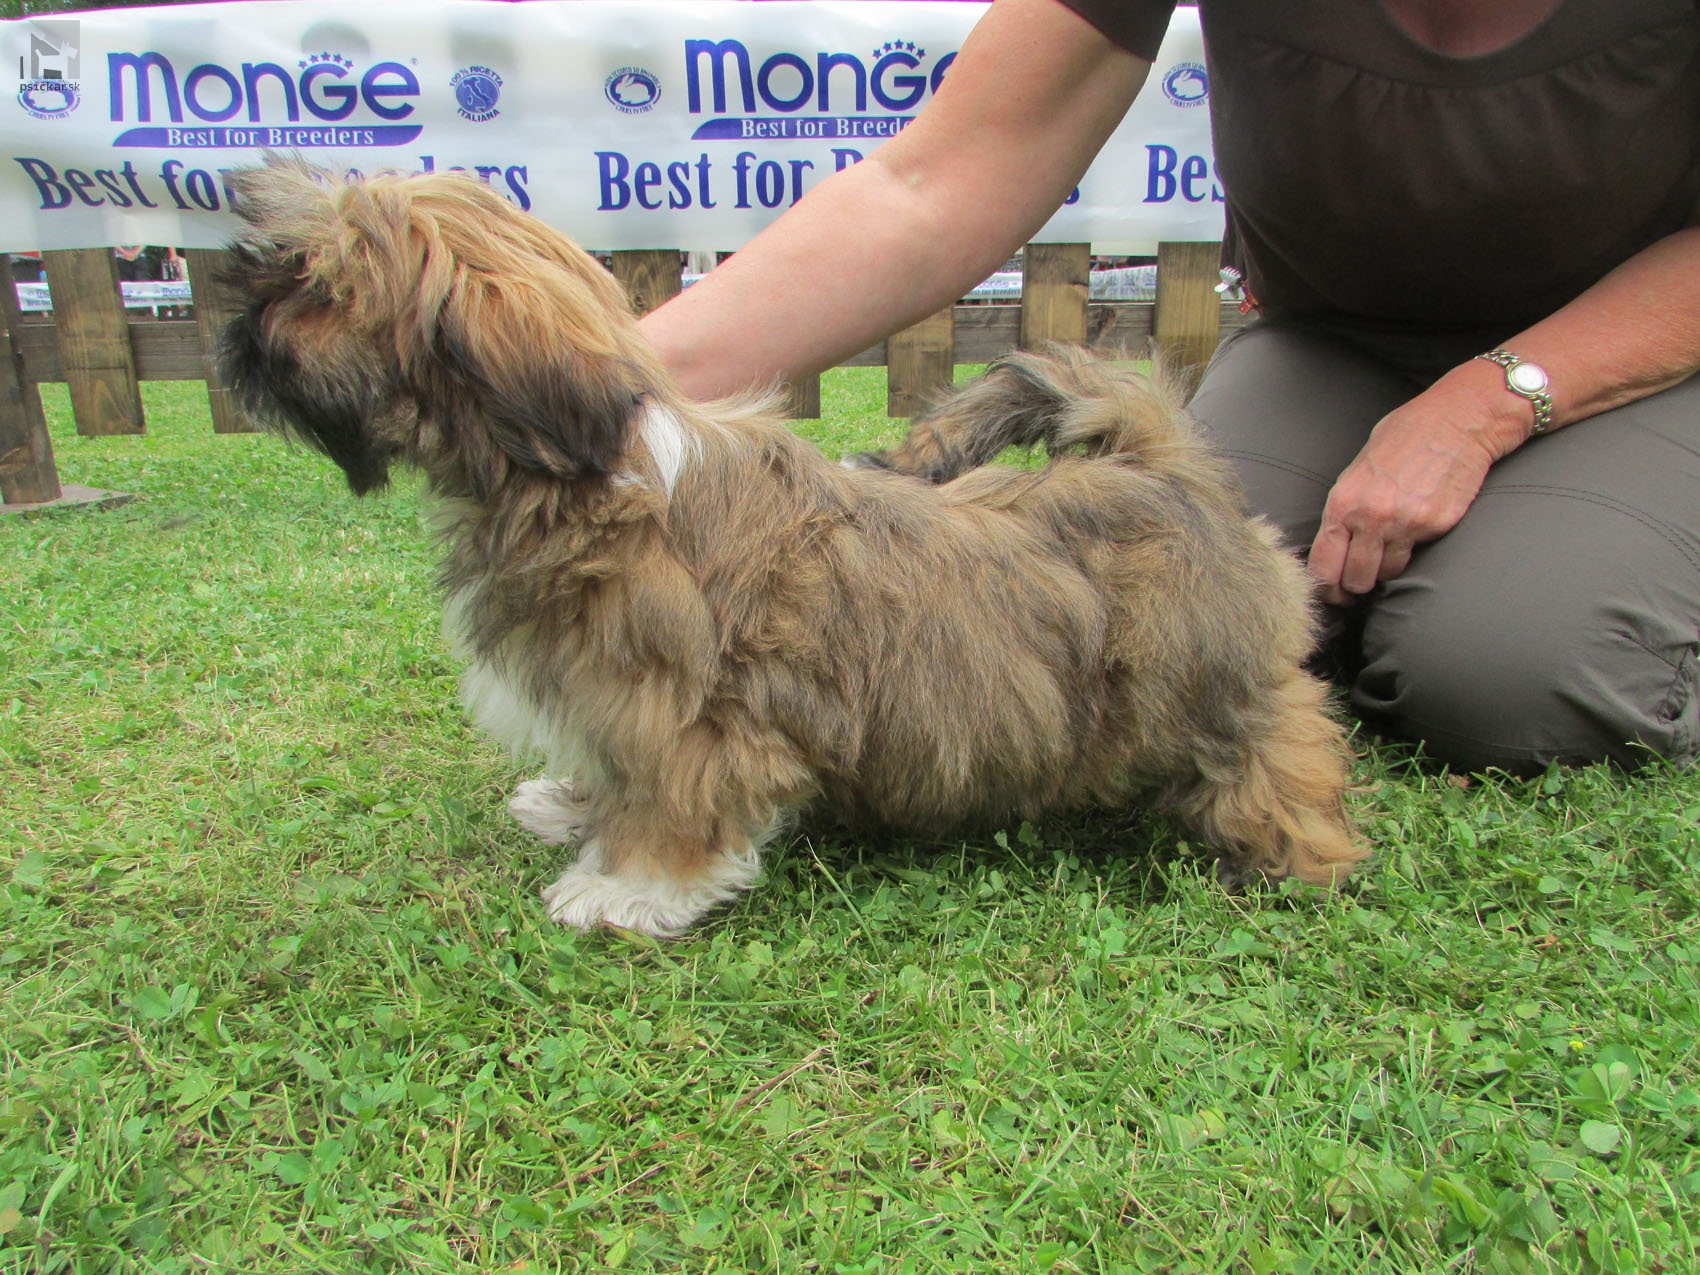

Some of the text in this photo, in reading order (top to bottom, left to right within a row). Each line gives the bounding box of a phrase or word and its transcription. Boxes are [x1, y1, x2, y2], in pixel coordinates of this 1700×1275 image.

[457, 107, 501, 122] ITALIANA
[167, 128, 375, 146] Best for Breeders
[740, 119, 788, 137] Best
[795, 118, 827, 137] for
[13, 157, 158, 209] Best
[593, 151, 717, 211] Best
[731, 151, 815, 209] for
